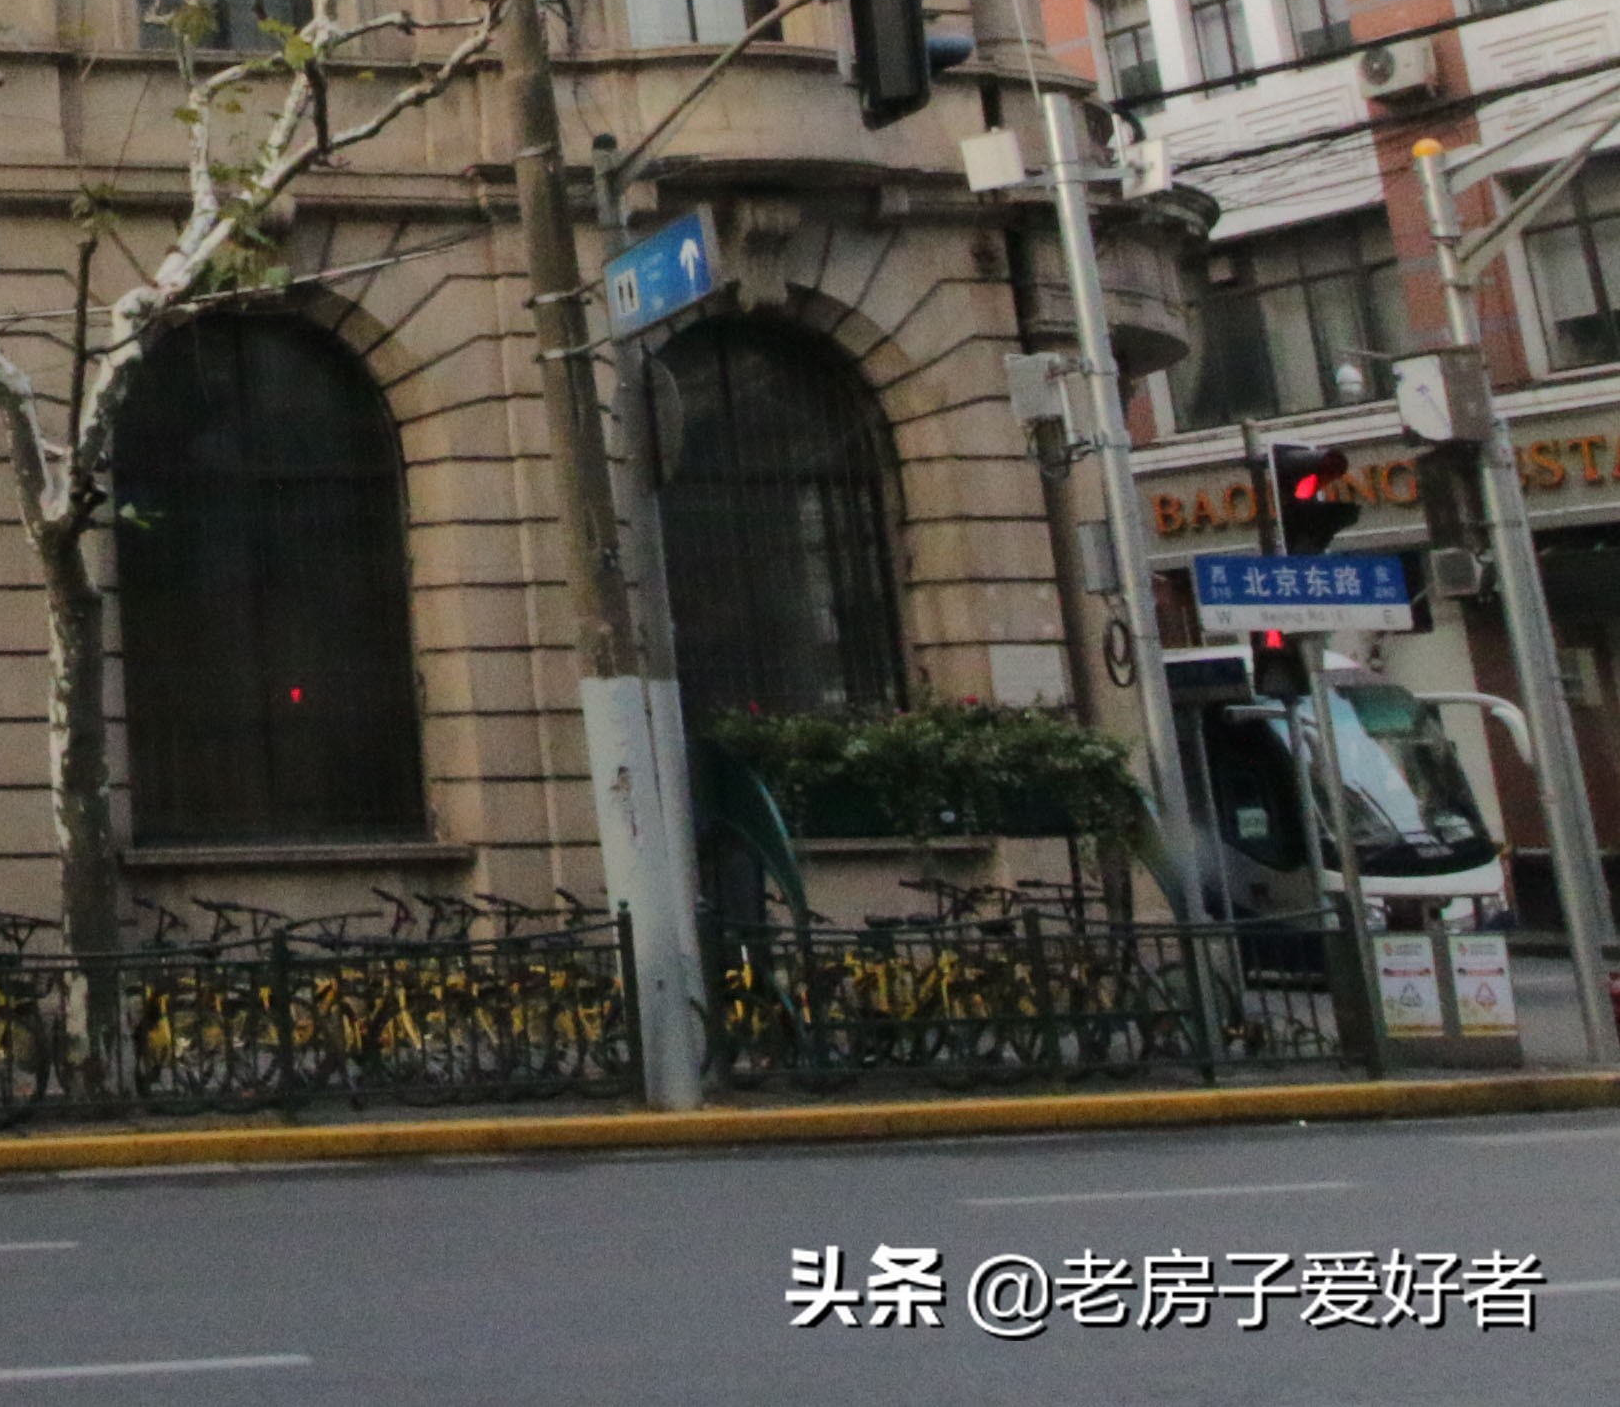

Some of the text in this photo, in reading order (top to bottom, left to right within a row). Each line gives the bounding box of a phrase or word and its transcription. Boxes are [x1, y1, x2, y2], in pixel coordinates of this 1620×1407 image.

[1243, 564, 1362, 597] 北京东路
[1215, 609, 1231, 625] W
[1383, 609, 1394, 625] E
